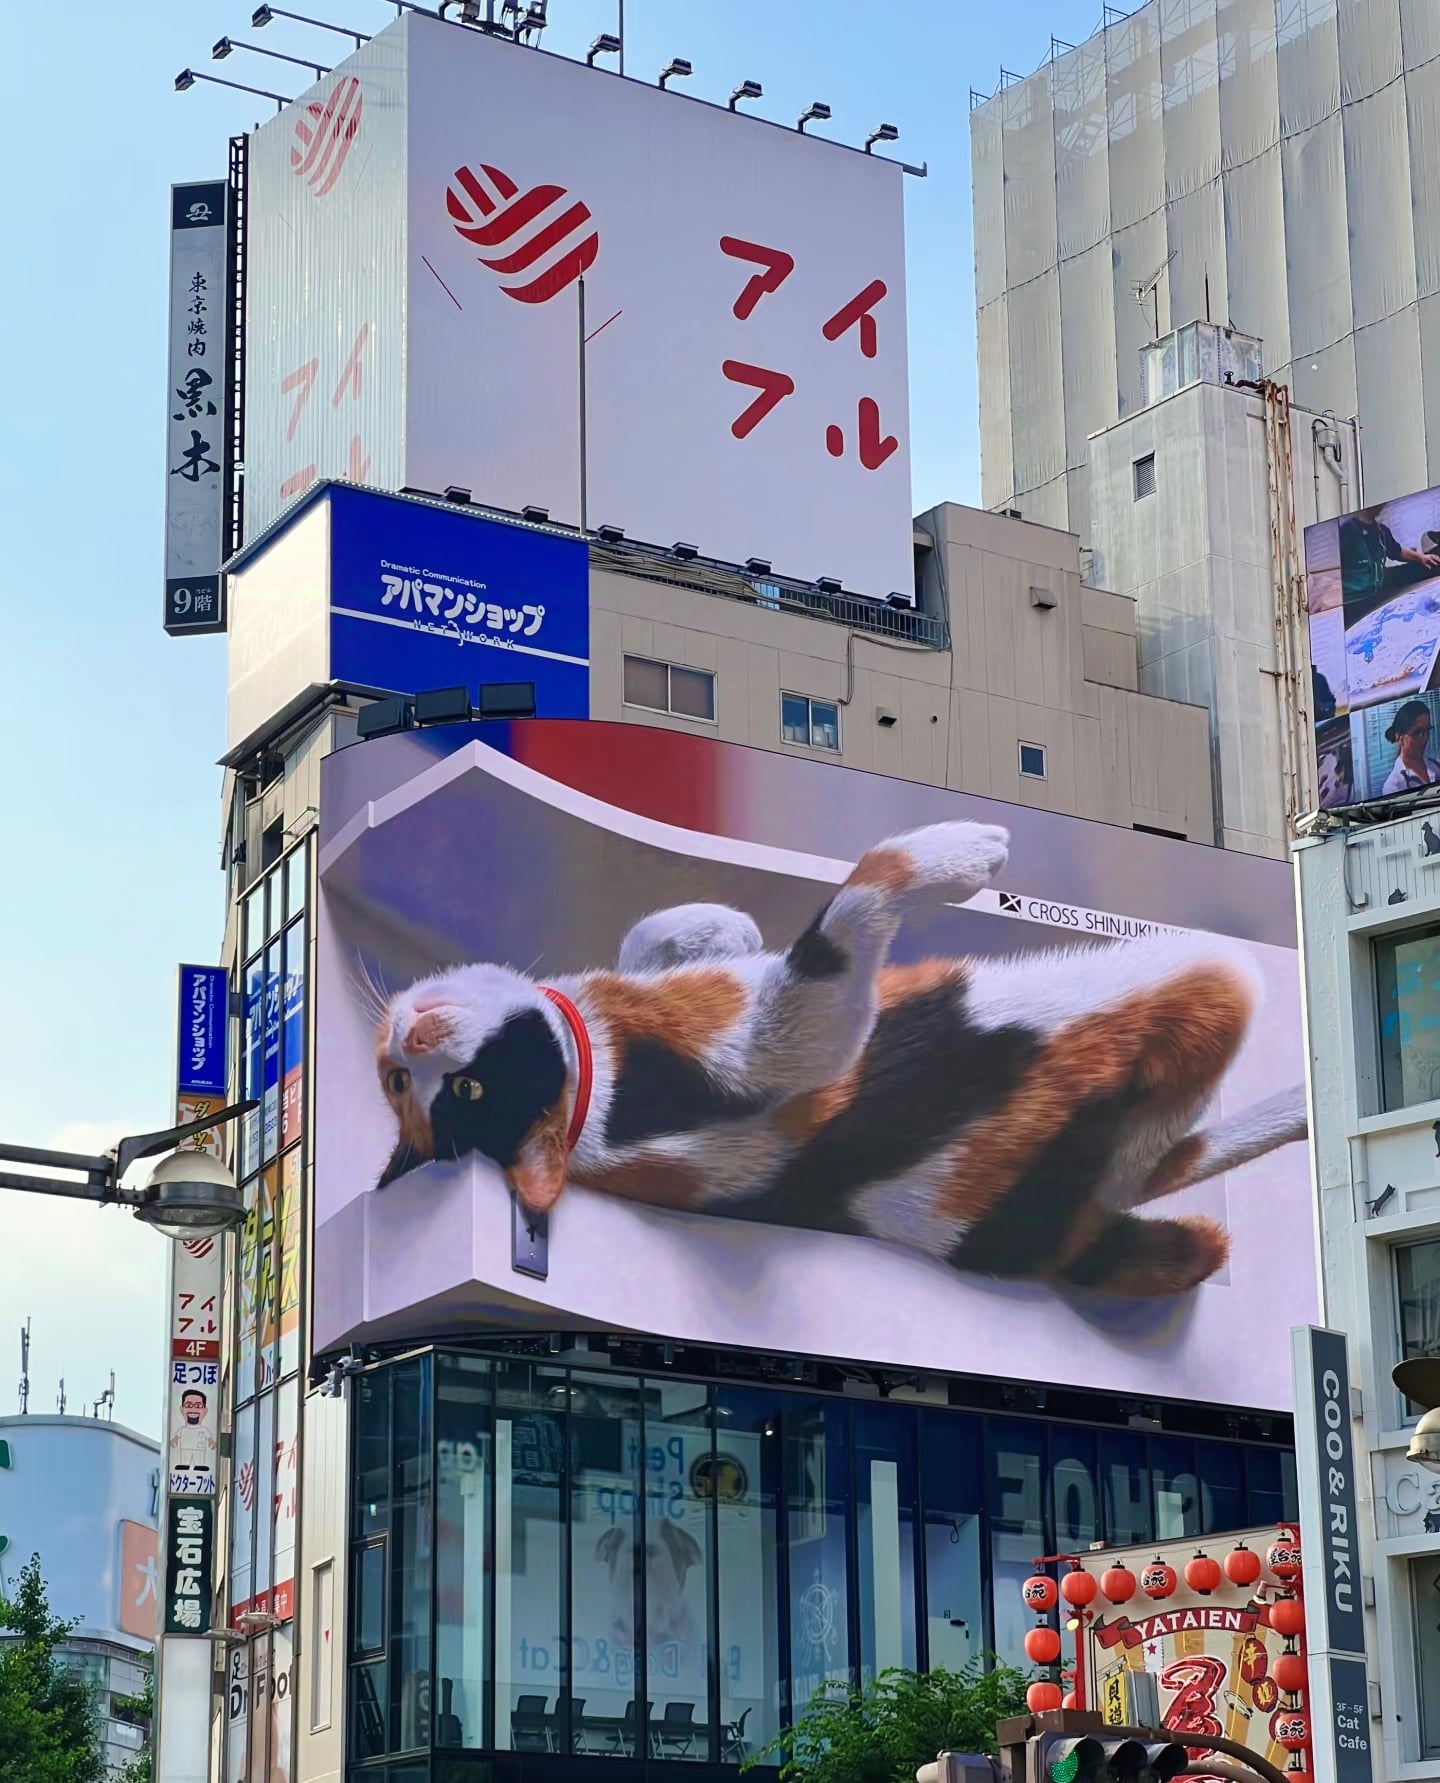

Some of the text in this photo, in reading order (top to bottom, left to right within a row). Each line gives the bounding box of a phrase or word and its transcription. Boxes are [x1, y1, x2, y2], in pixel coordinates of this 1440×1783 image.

[170, 367, 221, 483] 黒木
[380, 559, 487, 590] Dramatic Communication
[380, 573, 546, 637] アパマンショップ
[1028, 901, 1079, 928] CROSS
[191, 973, 207, 1071] アパマンショップ
[185, 1341, 207, 1357] 4F
[172, 1362, 218, 1385] 足つぼ
[169, 1473, 216, 1495] ドクターフット
[1322, 1369, 1353, 1614] COO & RIKU
[173, 1506, 205, 1628] 宝石広場
[1134, 1609, 1242, 1640] YATAIEN
[1337, 1714, 1360, 1730] Cat
[1338, 1734, 1368, 1751] Cafe
